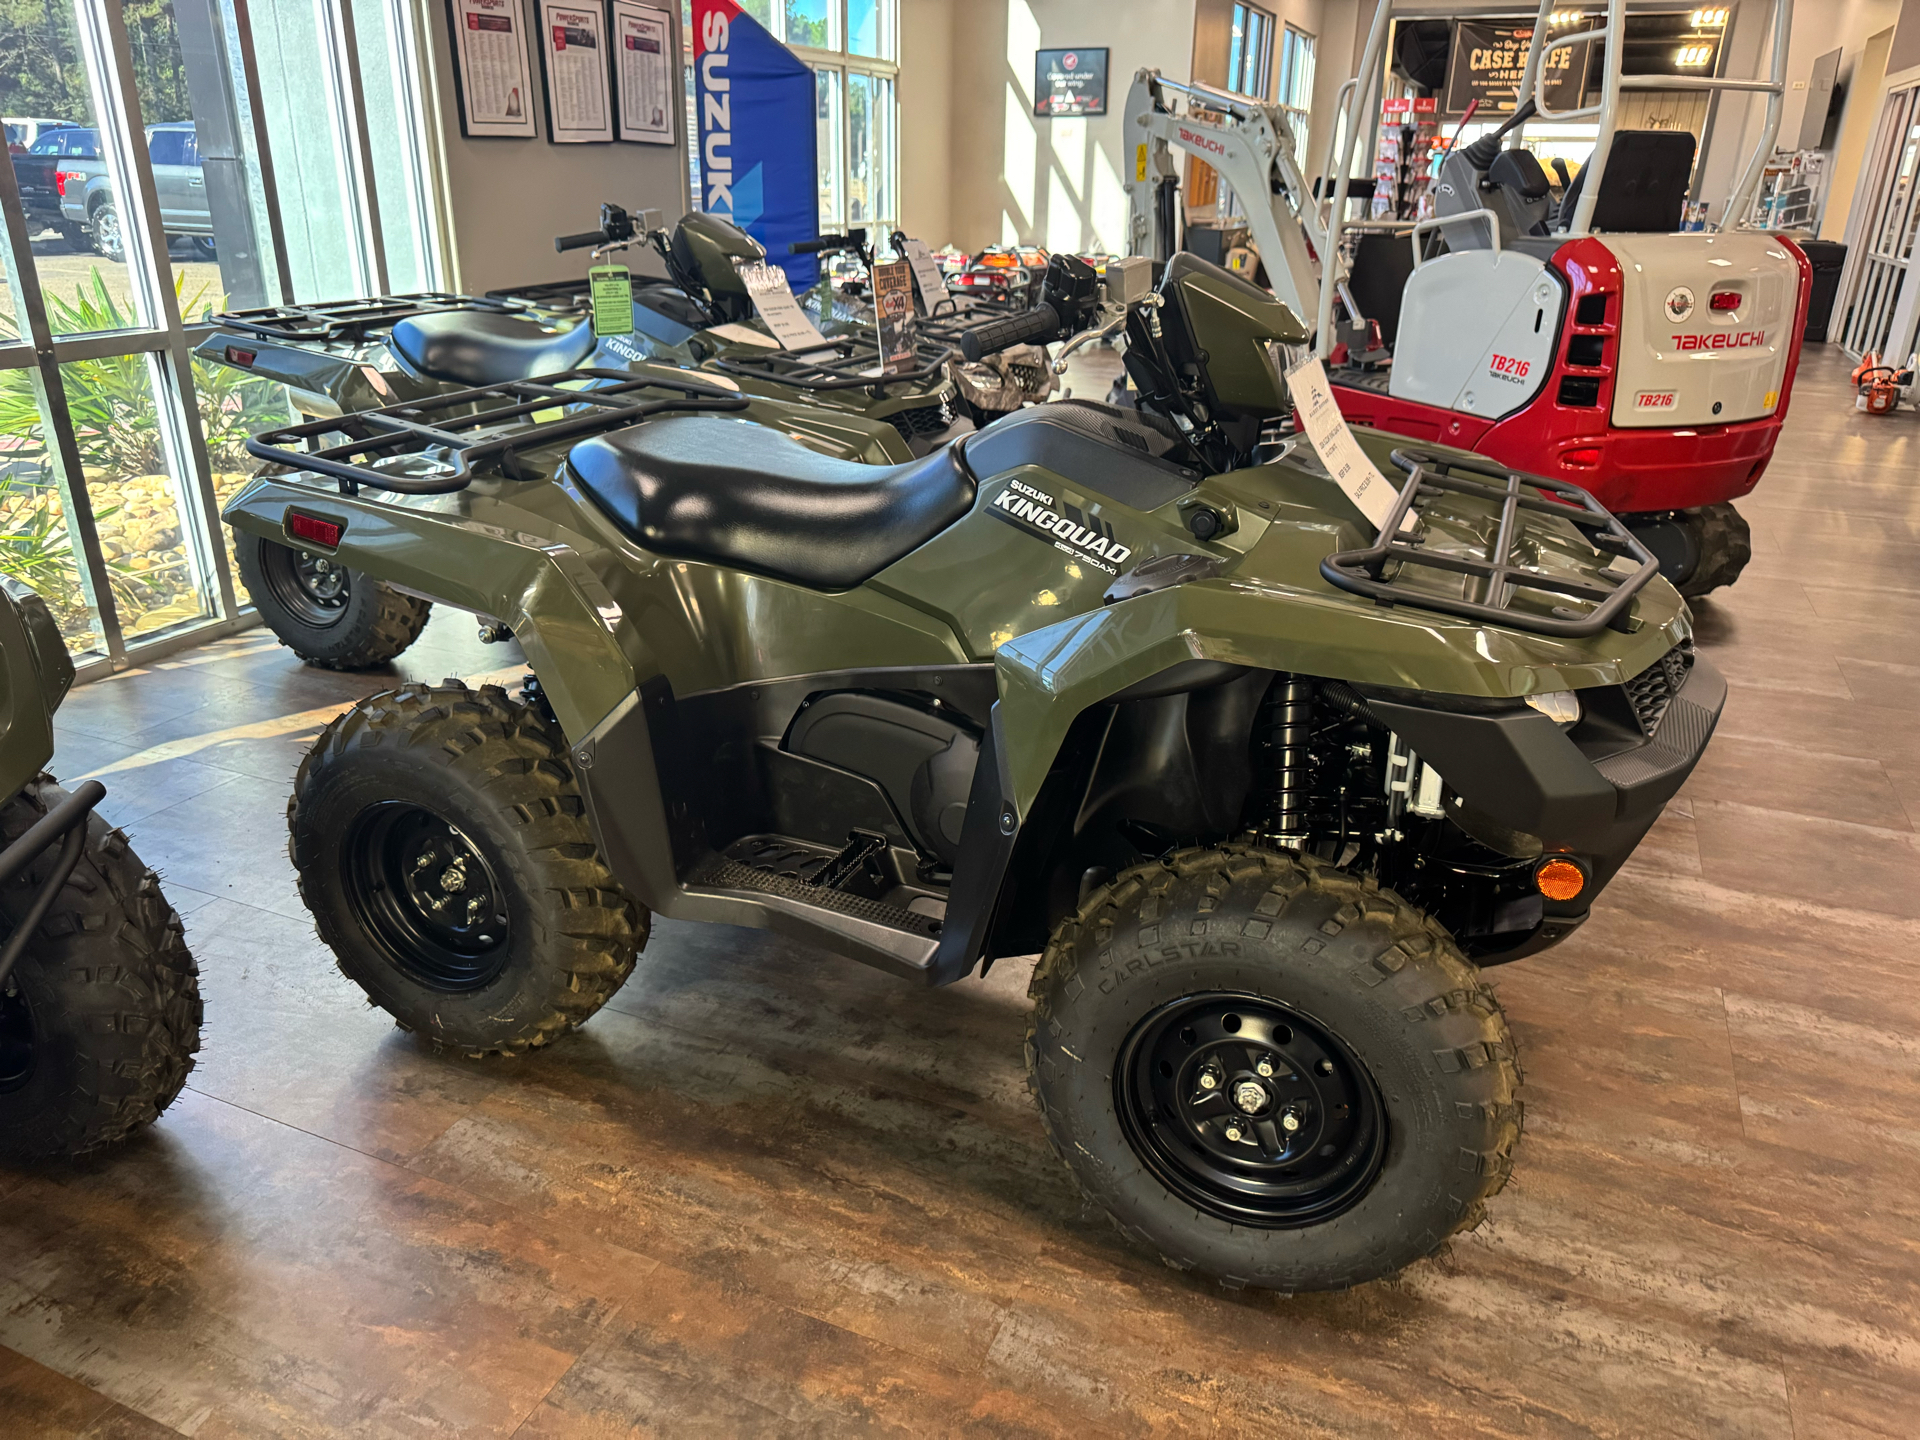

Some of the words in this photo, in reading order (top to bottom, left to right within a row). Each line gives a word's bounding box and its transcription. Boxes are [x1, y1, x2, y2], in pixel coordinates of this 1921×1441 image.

[1470, 48, 1515, 71] CASE
[1500, 69, 1526, 80] HER
[1671, 331, 1766, 350] TAKEUCHI
[1490, 353, 1531, 378] TB216
[1489, 370, 1526, 386] TAKEUCHI
[1637, 393, 1675, 407] TB216
[1009, 478, 1054, 506] SUZUKI
[993, 489, 1132, 564] KINGQUAD
[1097, 941, 1241, 996] CARLSTAR
